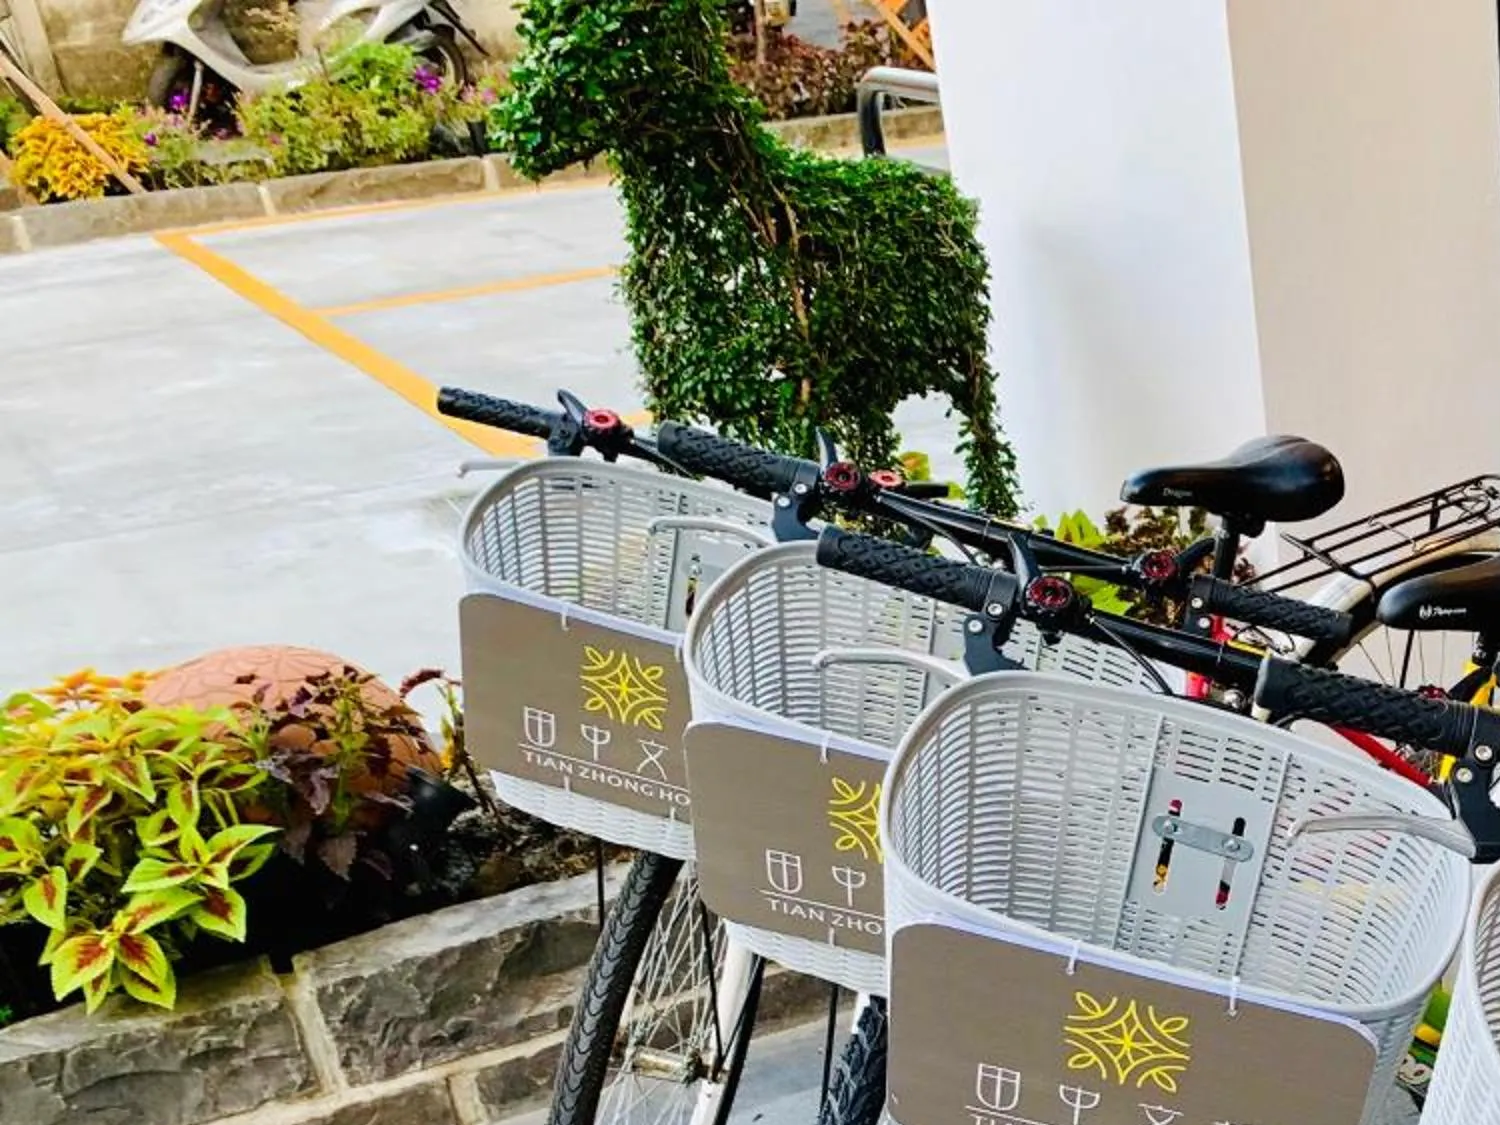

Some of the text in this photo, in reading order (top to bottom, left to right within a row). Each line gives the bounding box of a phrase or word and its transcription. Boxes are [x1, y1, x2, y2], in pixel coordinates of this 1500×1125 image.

[523, 706, 669, 781] 田中文
[521, 749, 573, 773] TIAN
[579, 766, 653, 796] ZHONG
[764, 898, 883, 935] TIAN ZHO
